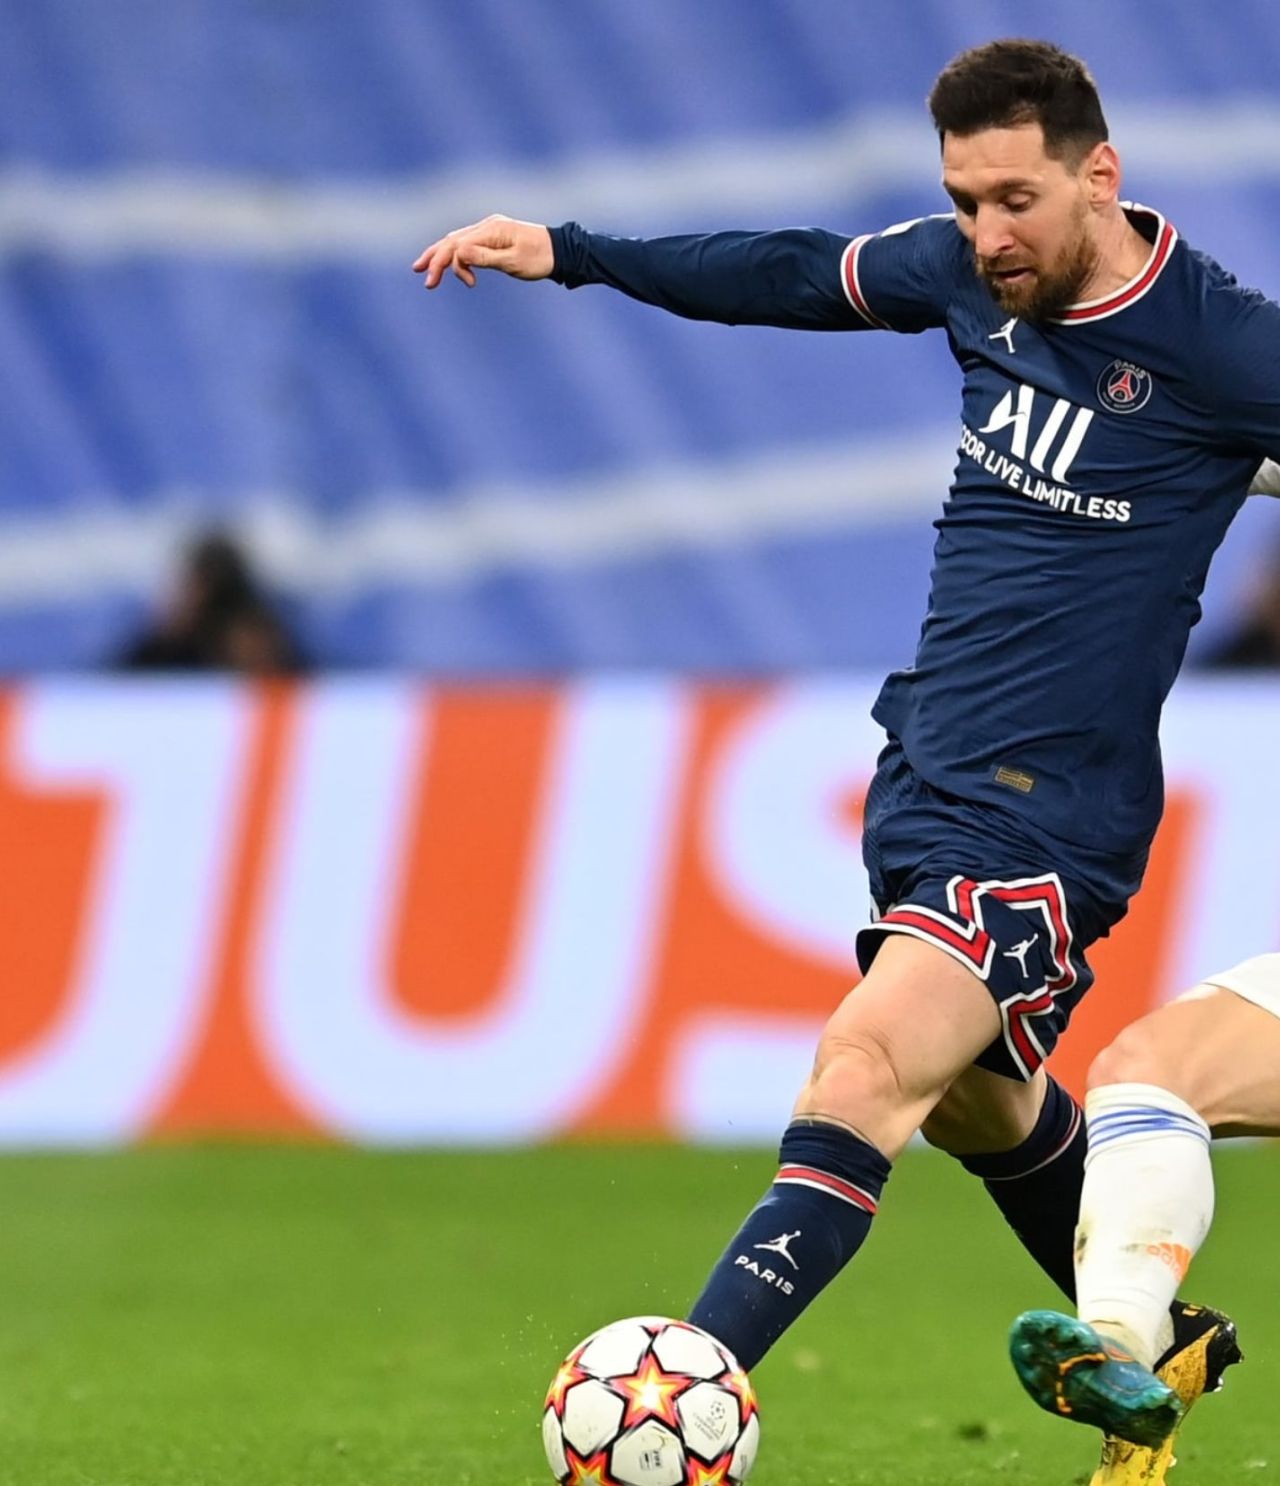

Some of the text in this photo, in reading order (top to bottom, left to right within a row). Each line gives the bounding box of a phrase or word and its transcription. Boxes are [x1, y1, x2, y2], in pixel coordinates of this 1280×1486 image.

[984, 449, 1024, 489] LIVE
[1022, 474, 1132, 523] LIMITLESS
[734, 1254, 795, 1295] PARIS
